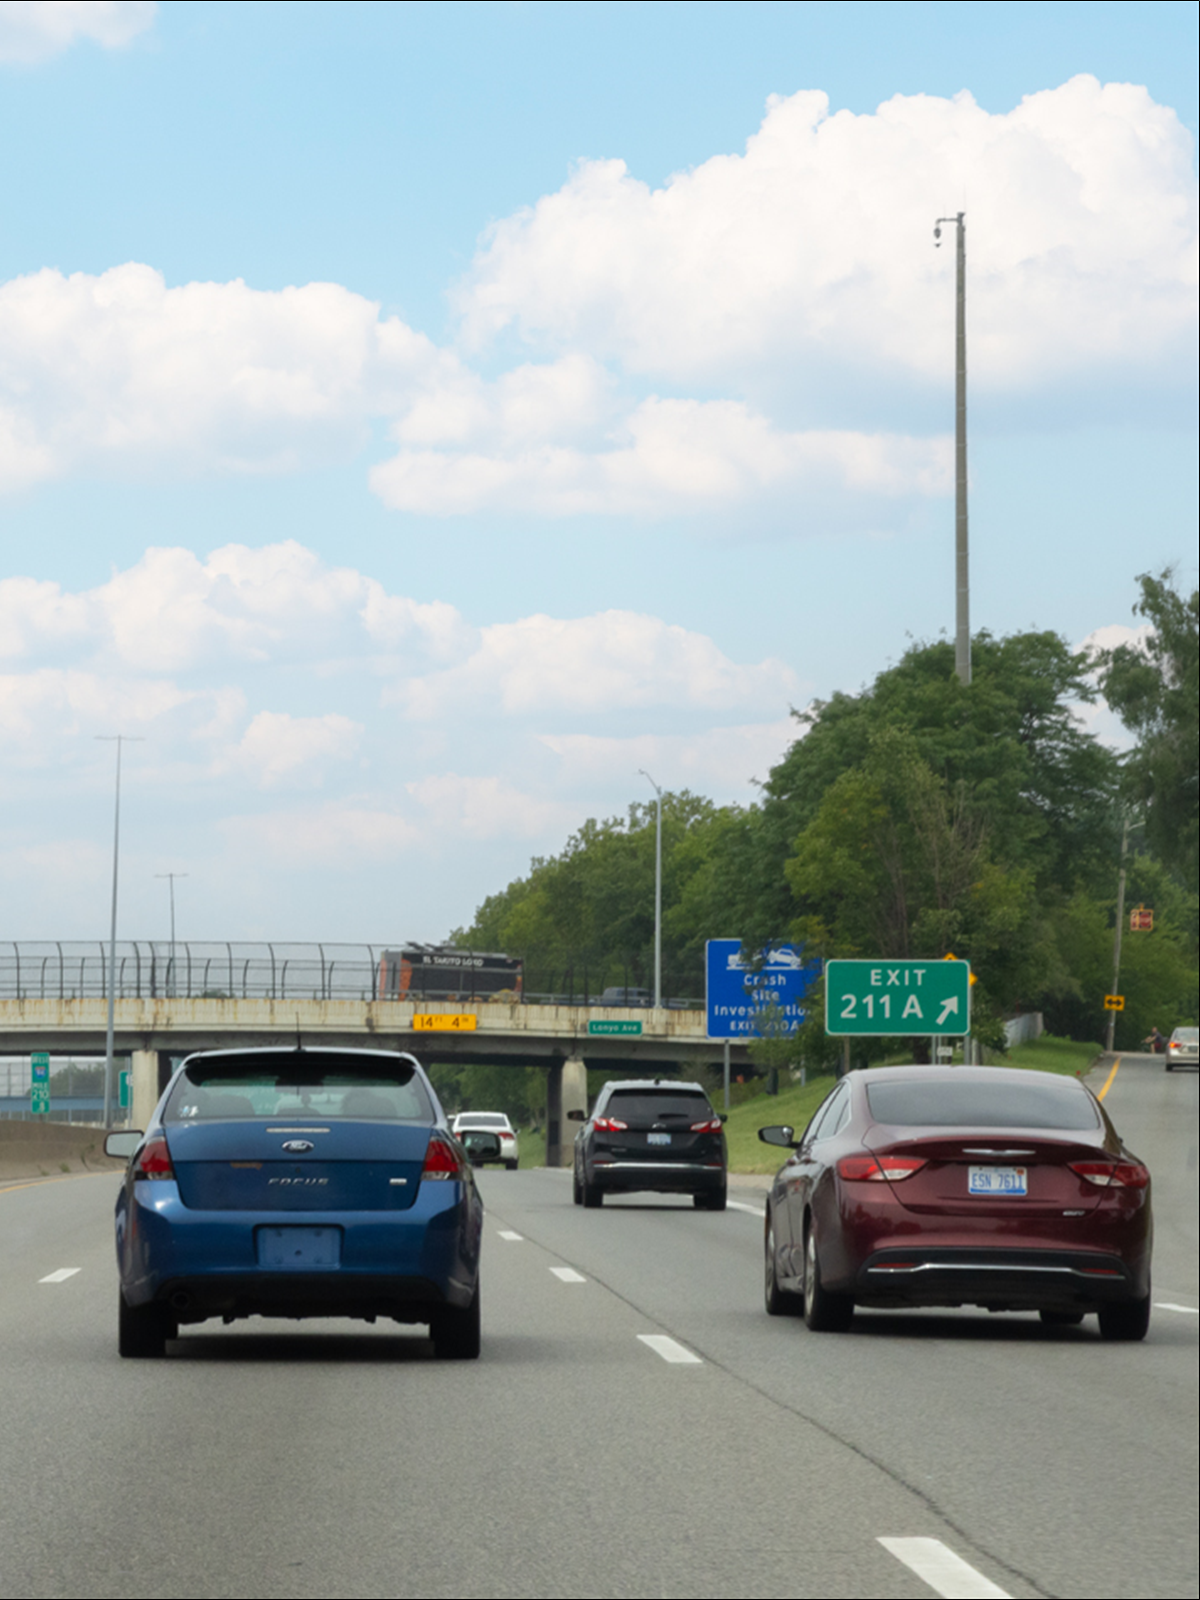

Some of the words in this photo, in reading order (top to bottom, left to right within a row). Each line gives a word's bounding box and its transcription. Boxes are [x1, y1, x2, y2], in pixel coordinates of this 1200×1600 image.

[870, 969, 926, 986] EXIT
[752, 989, 780, 1001] Site
[714, 1004, 811, 1017] Investitio
[421, 1016, 433, 1028] 14
[452, 1016, 460, 1028] 4
[621, 1024, 638, 1032] Ave
[972, 1173, 992, 1188] ESN
[998, 1173, 1023, 1189] 7611
